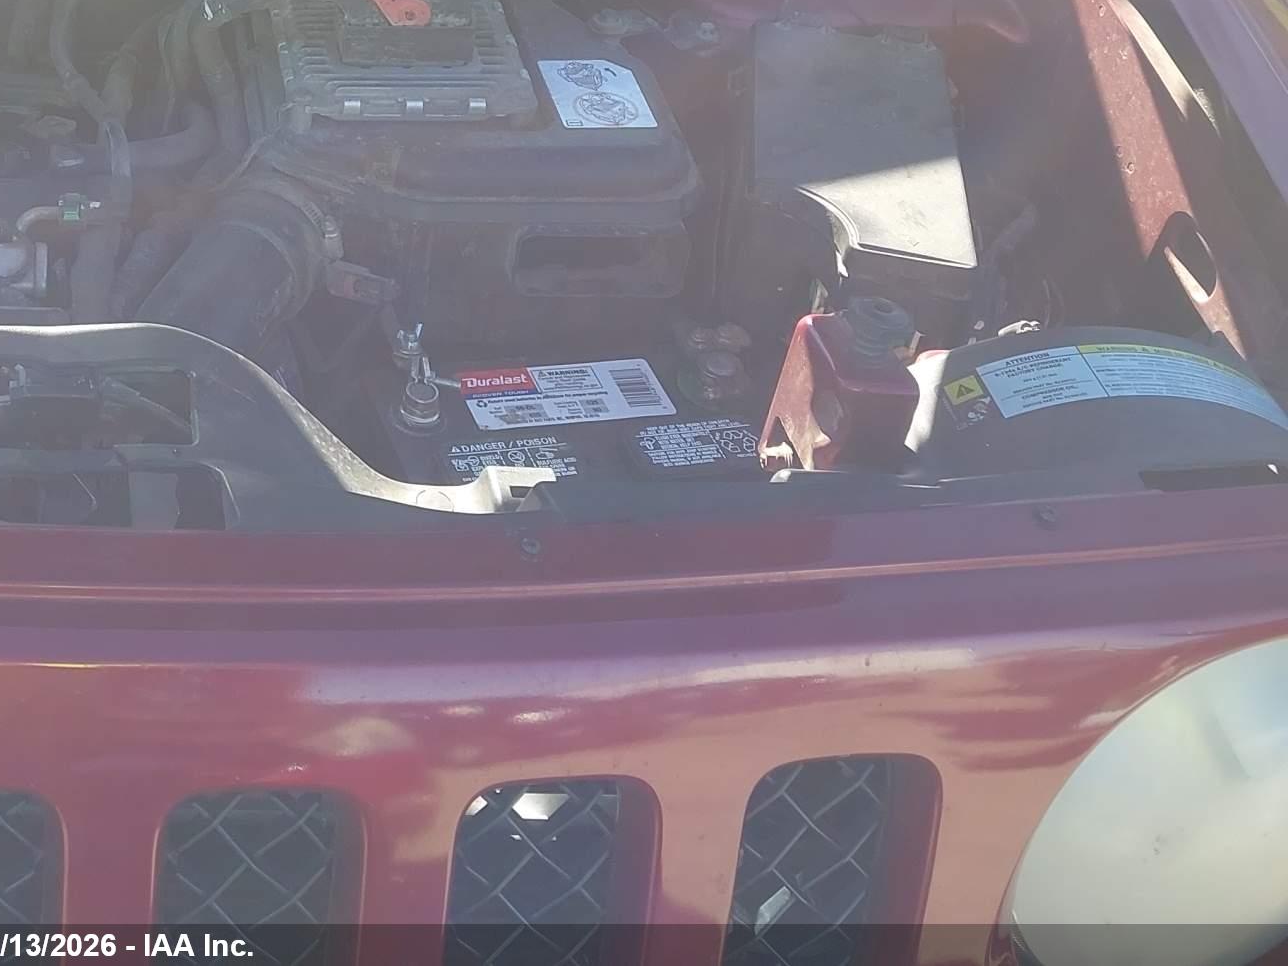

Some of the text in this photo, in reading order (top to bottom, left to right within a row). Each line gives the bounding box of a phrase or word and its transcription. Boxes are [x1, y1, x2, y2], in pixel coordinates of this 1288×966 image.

[461, 373, 529, 388] Duralast
[460, 441, 507, 453] DANGER
[515, 436, 558, 447] POISON
